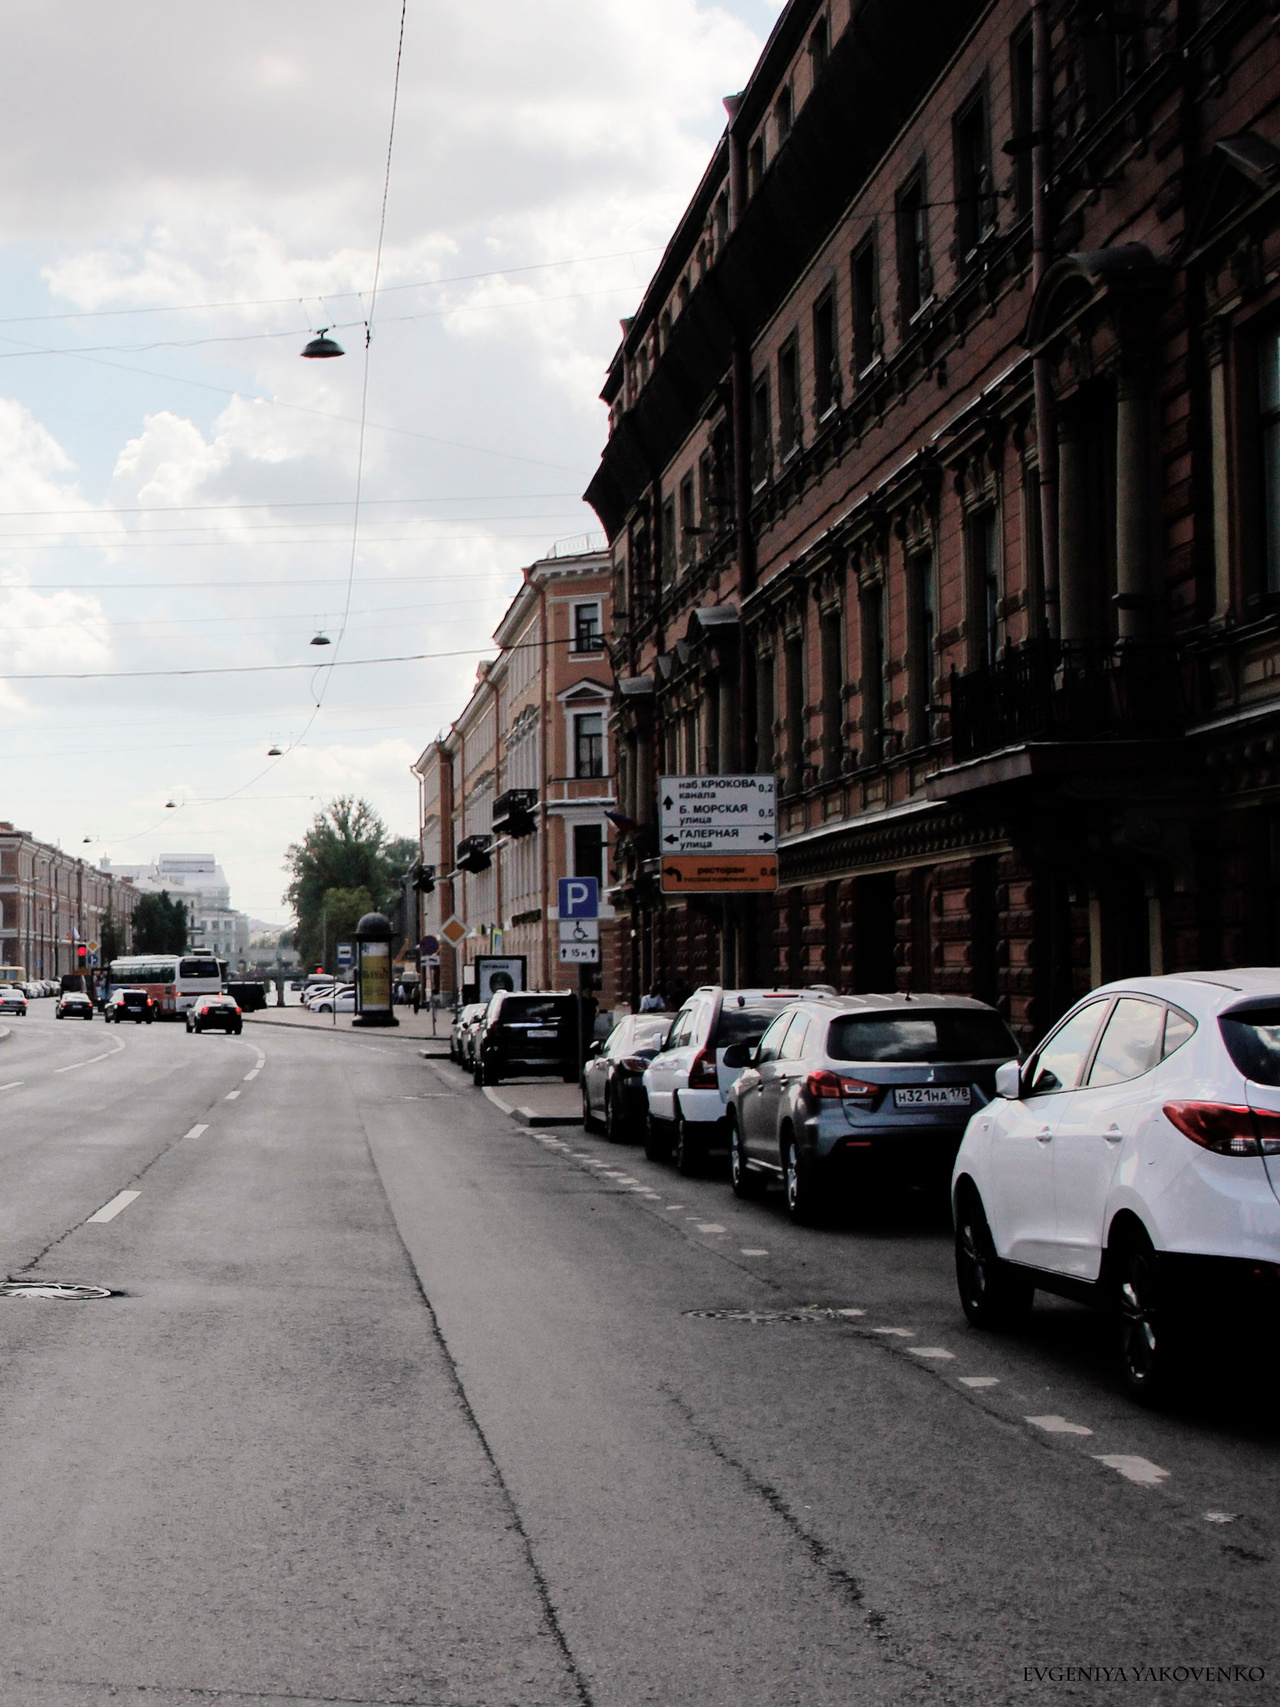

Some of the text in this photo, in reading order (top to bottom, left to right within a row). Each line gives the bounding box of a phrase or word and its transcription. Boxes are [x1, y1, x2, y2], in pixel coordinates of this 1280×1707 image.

[758, 784, 773, 793] 0,2
[679, 791, 716, 799] канала
[679, 804, 748, 814] Б. МОРСКАЯ
[758, 809, 774, 818] 0,5
[679, 816, 712, 825] улица
[680, 829, 739, 838] ГАЛЕРНАЯ
[680, 841, 712, 850] улица
